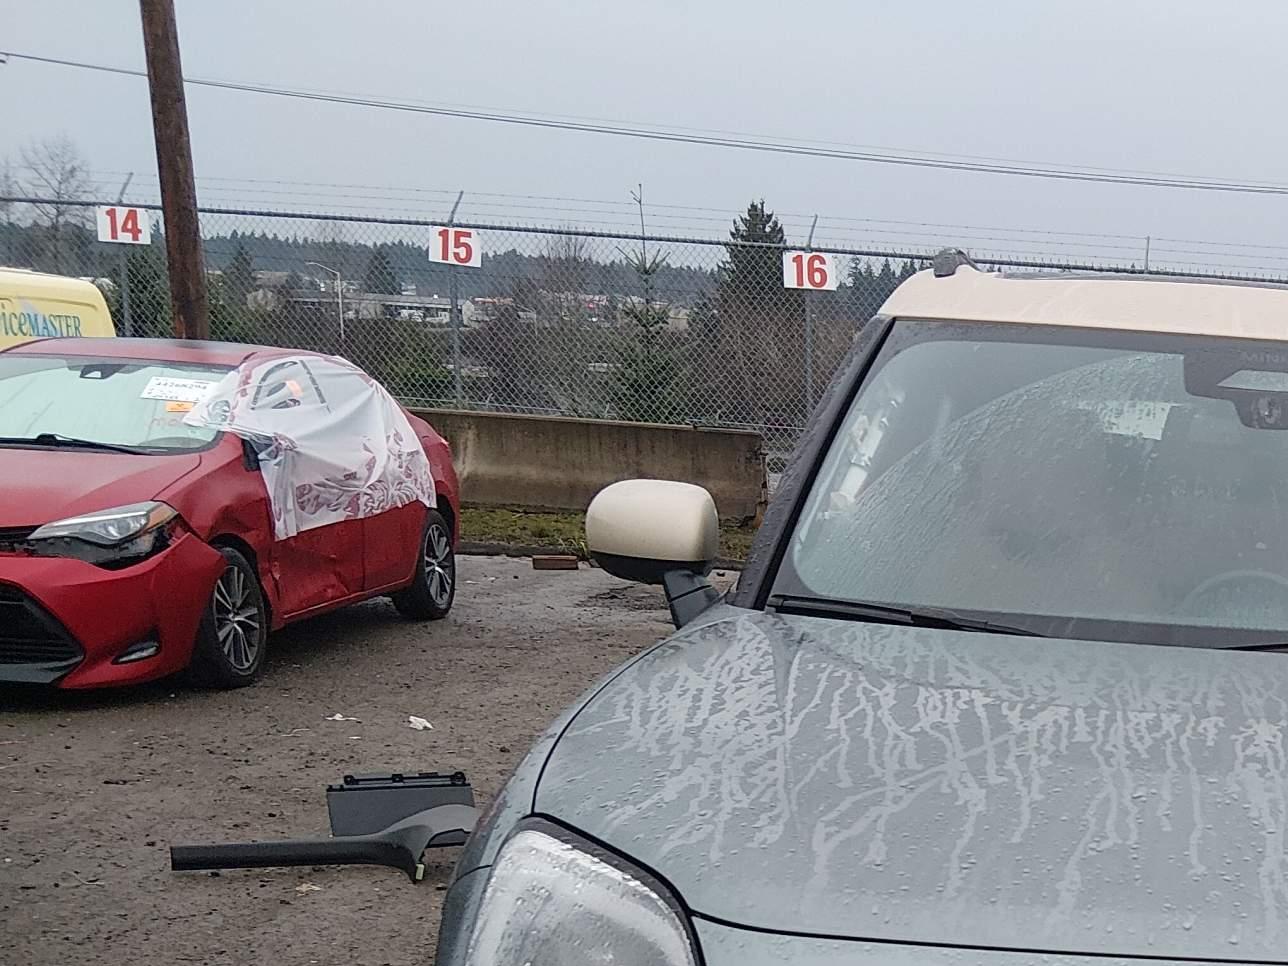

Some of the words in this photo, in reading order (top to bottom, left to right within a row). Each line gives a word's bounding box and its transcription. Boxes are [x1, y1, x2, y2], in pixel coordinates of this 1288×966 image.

[106, 208, 142, 241] 14
[438, 229, 472, 264] 15
[792, 254, 828, 288] 16
